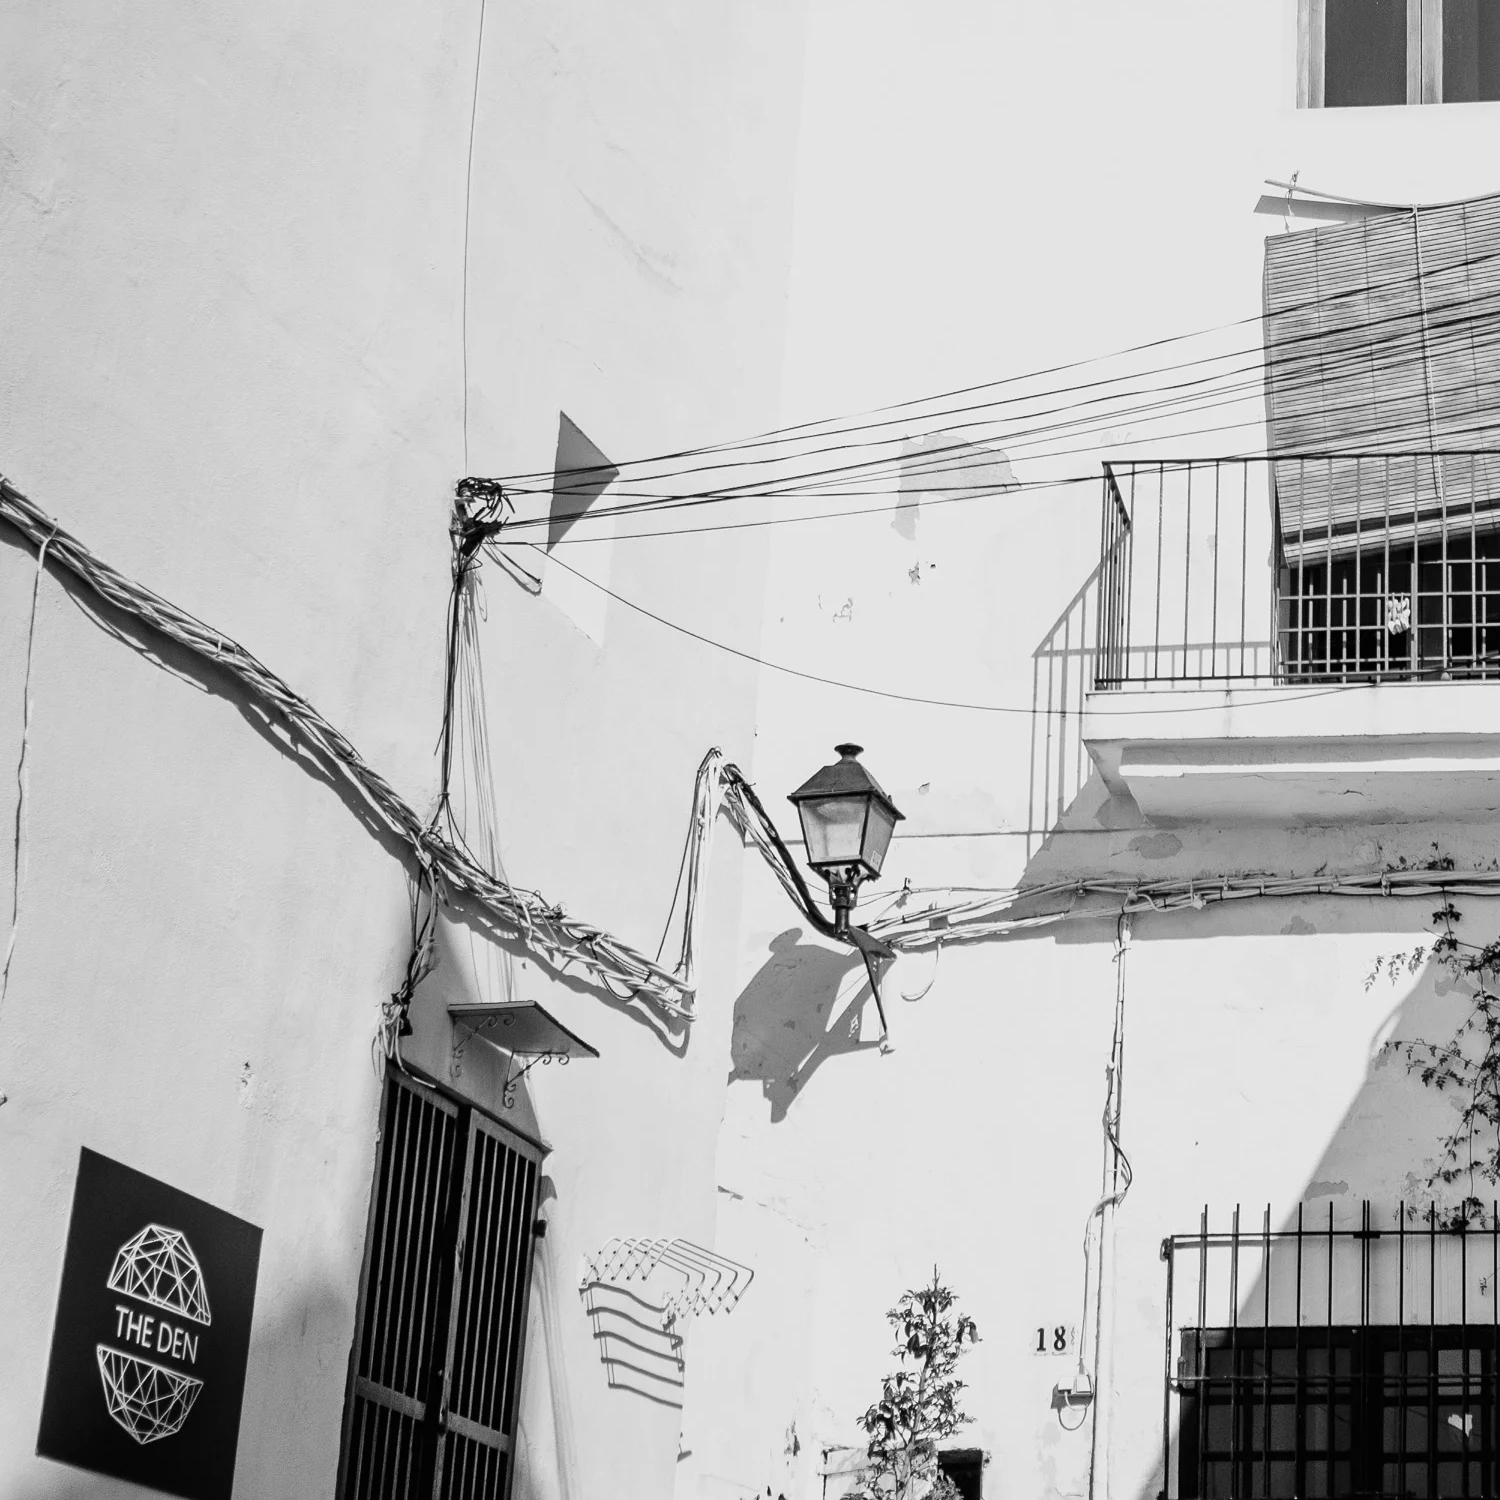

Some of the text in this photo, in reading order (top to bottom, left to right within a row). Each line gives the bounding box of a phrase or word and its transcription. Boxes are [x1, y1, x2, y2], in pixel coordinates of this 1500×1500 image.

[115, 1304, 199, 1365] THE DEN
[1036, 1325, 1067, 1352] 18
